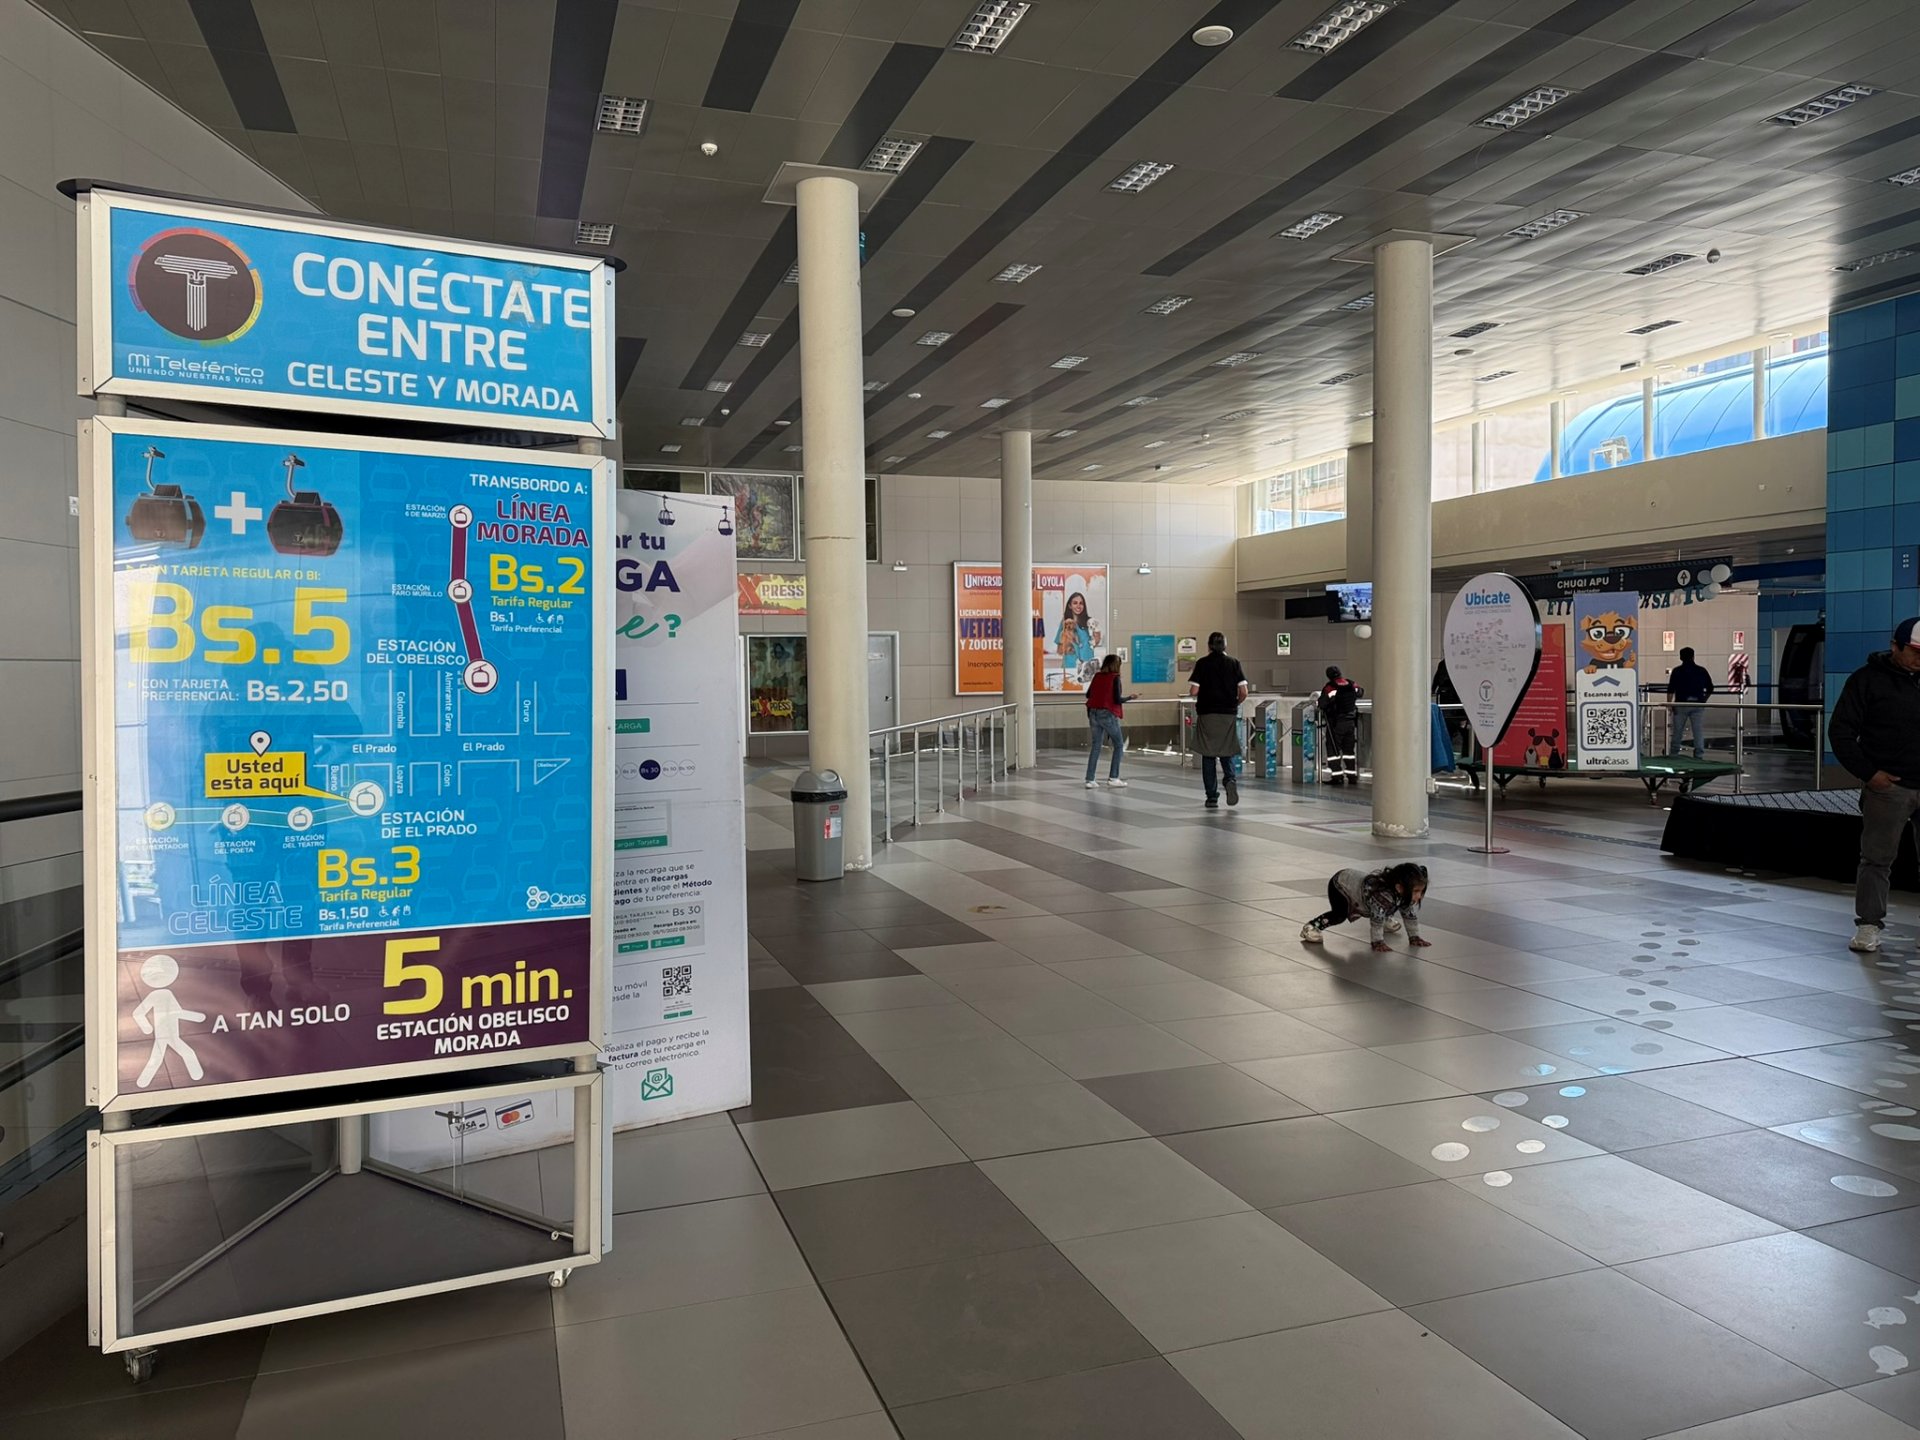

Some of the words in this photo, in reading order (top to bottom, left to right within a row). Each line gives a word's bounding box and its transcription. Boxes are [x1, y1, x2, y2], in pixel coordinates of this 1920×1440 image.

[293, 252, 590, 329] CONÉCTATE
[357, 313, 527, 371] ENTRE
[128, 366, 175, 377] UNIENDO
[179, 371, 231, 382] NUESTRAS
[235, 376, 264, 385] VIDAS
[288, 361, 418, 397] CELESTE
[427, 376, 447, 399] Y
[456, 379, 579, 413] MORADA
[470, 473, 570, 494] TRANSBORDO
[574, 482, 588, 495] A:
[406, 504, 446, 513] ESTACIÓN
[497, 493, 571, 523] LÍNEA
[476, 522, 590, 548] MORADA
[640, 532, 666, 551] tu
[172, 565, 229, 578] TARJETA
[233, 568, 291, 580] REGULAR
[295, 569, 301, 580] O
[489, 554, 586, 595] Bs.2
[392, 584, 431, 592] ESTACIÓN
[1557, 579, 1587, 590] CHUQI
[1589, 576, 1610, 587] APU
[491, 596, 525, 607] Tarifa
[528, 597, 573, 611] Regular
[1466, 589, 1511, 606] Ubicate
[490, 612, 514, 623] Bs.1
[960, 609, 1002, 617] LICENCIATURA
[129, 582, 351, 665] Bs.5
[491, 625, 514, 633] Tarifa
[515, 625, 563, 635] Preferencial
[378, 639, 457, 653] ESTACIÓN
[960, 640, 967, 651] Y
[367, 653, 394, 664] DEL
[397, 653, 466, 666] OBELISCO
[142, 679, 168, 690] CON
[172, 679, 230, 691] TARJETA
[247, 680, 348, 704] Bs.2,50
[445, 671, 454, 712] Almirante
[142, 691, 240, 702] PREFERENCIAL:
[397, 691, 406, 730] Colombia
[523, 700, 531, 723] Oruro
[445, 713, 454, 732] Grau
[353, 744, 362, 754] El
[366, 744, 397, 754] Prado
[463, 743, 473, 752] El
[476, 742, 505, 752] Prado
[227, 758, 284, 775] Usted
[211, 776, 253, 791] esta
[260, 773, 301, 794] aquí
[331, 766, 340, 791] Bueno
[381, 808, 466, 826] ESTACIÓN
[285, 834, 325, 843] ESTACIÓN
[381, 826, 402, 839] DE
[406, 826, 424, 838] EL
[427, 824, 478, 837] PRADO
[215, 840, 256, 849] ESTACIÓN
[318, 845, 420, 889] Bs.3
[636, 867, 667, 876] recarga
[651, 874, 689, 883] Recargas
[652, 883, 671, 892] elige
[682, 880, 713, 888] Método
[191, 874, 284, 908] LÍNEA
[320, 889, 358, 903] Tarifa
[362, 887, 413, 903] Regular
[672, 908, 685, 917] Bs
[688, 906, 701, 915] 30
[168, 906, 303, 936] CELESTE
[319, 923, 345, 931] Tarifa
[347, 919, 400, 930] Preferencial
[382, 936, 444, 1016] 5
[462, 960, 574, 1010] min.
[625, 981, 648, 991] móvil
[212, 1016, 229, 1034] A
[236, 1012, 287, 1033] TAN
[290, 1003, 351, 1029] SOLO
[377, 1012, 474, 1041] ESTACIÓN
[478, 1005, 570, 1030] OBELISCO
[435, 1032, 521, 1055] MORADA
[605, 1044, 635, 1054] Realiza
[646, 1038, 667, 1047] pago
[676, 1031, 700, 1041] recibe
[608, 1052, 639, 1062] factura
[641, 1049, 652, 1057] de
[664, 1043, 694, 1053] recarga
[626, 1059, 653, 1069] correo
[655, 1050, 699, 1063] electrónico
